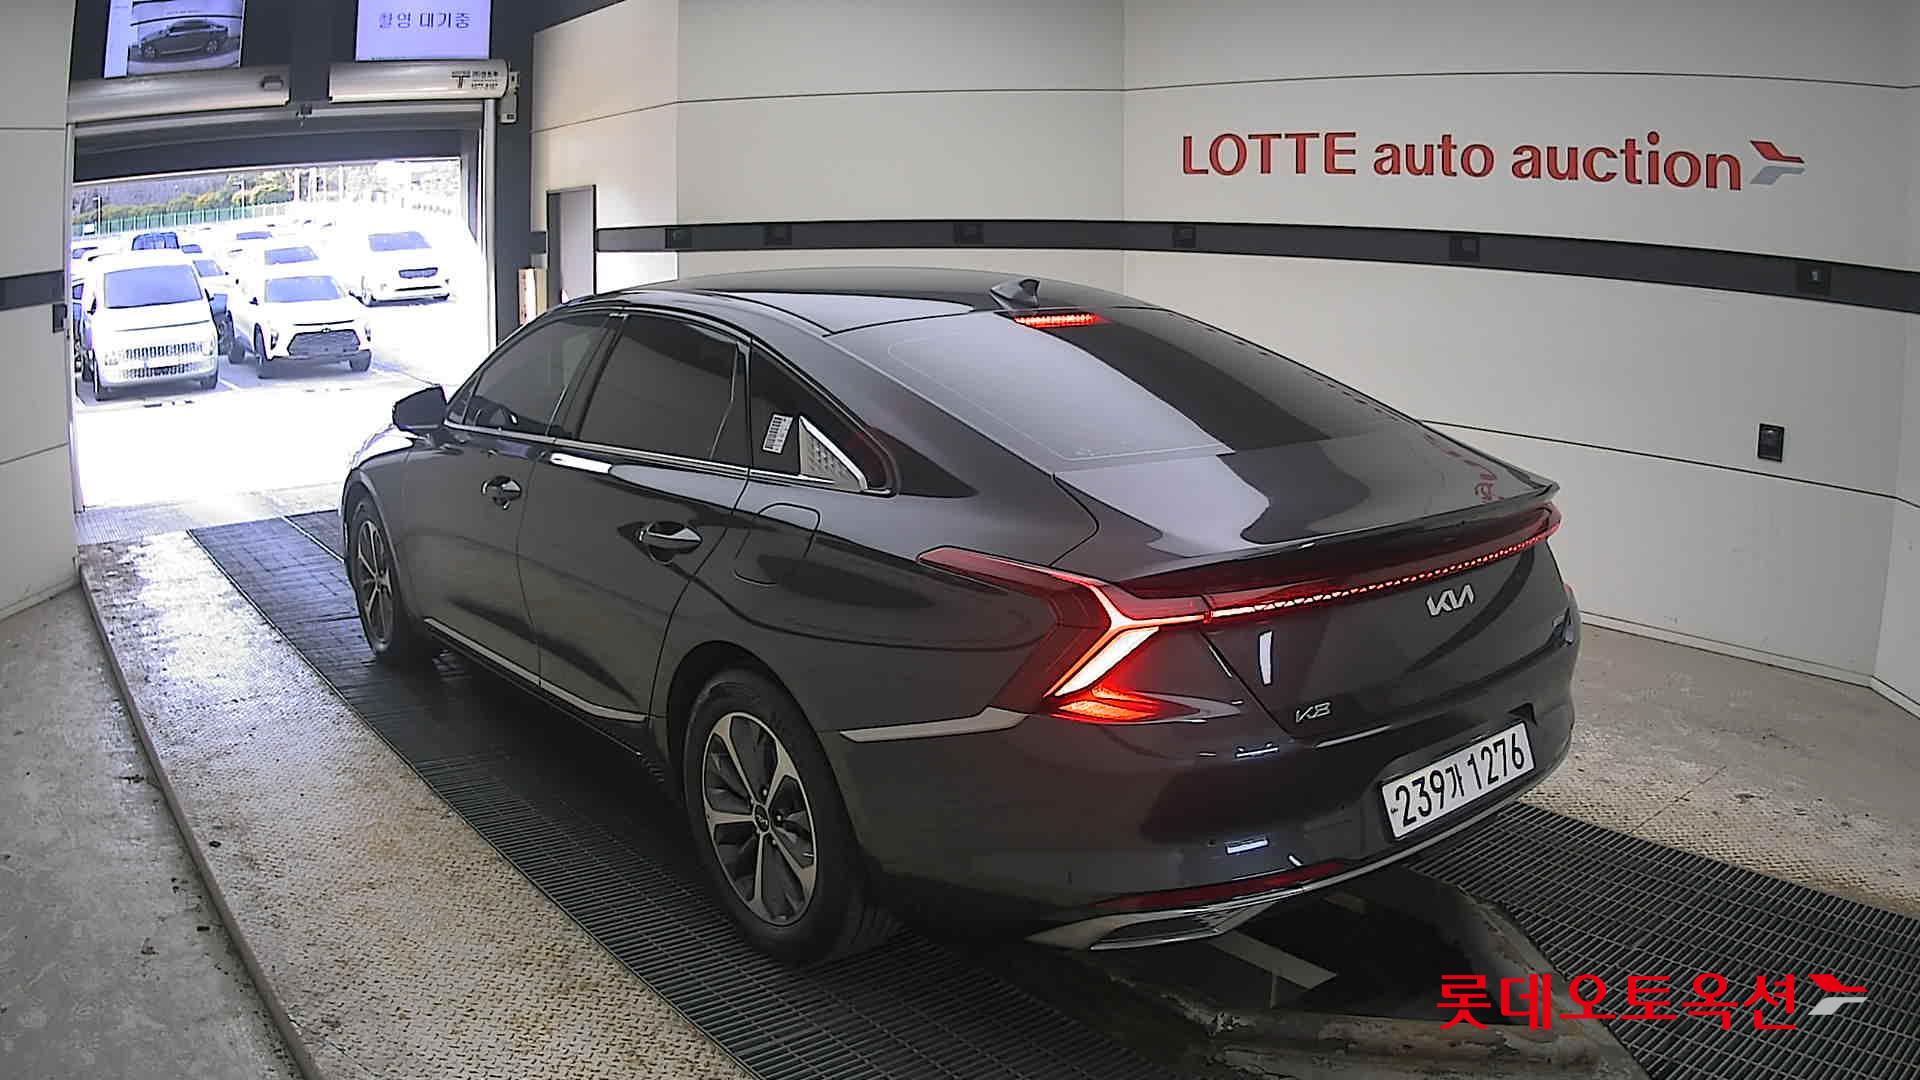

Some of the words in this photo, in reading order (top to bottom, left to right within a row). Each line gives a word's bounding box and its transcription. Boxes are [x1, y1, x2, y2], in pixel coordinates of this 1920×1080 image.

[419, 11, 472, 29] 대기중
[1181, 131, 1358, 176] LOTTE
[1373, 133, 1496, 179] auto
[1511, 130, 1743, 191] auction
[1426, 584, 1475, 616] KIA
[1295, 701, 1332, 723] K8
[1394, 763, 1465, 828] 239가
[1467, 732, 1525, 791] 1276
